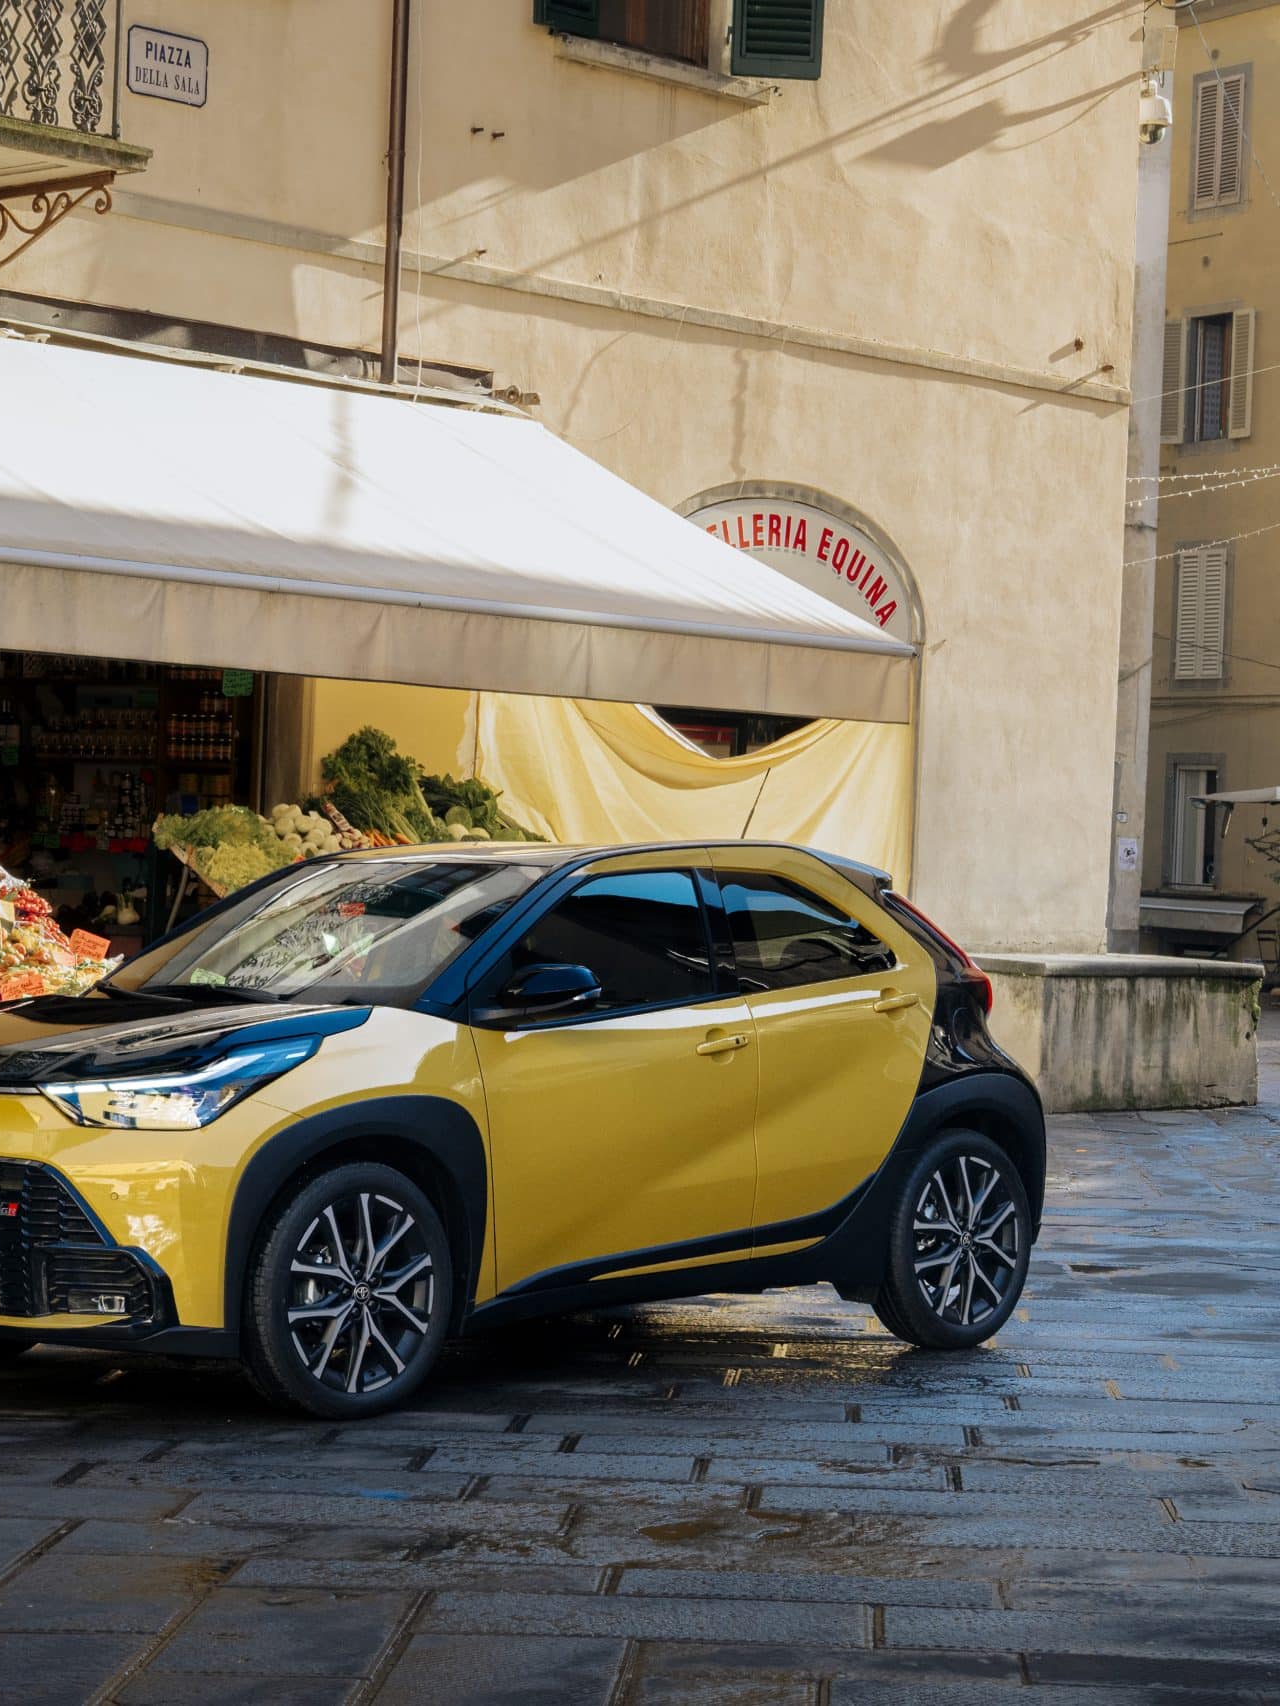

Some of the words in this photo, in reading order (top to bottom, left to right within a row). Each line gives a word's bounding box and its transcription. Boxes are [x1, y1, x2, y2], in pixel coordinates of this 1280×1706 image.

[145, 41, 192, 69] PIAZZA
[135, 66, 168, 88] DELLA
[174, 74, 201, 95] SALA
[816, 527, 898, 628] EQUINA
